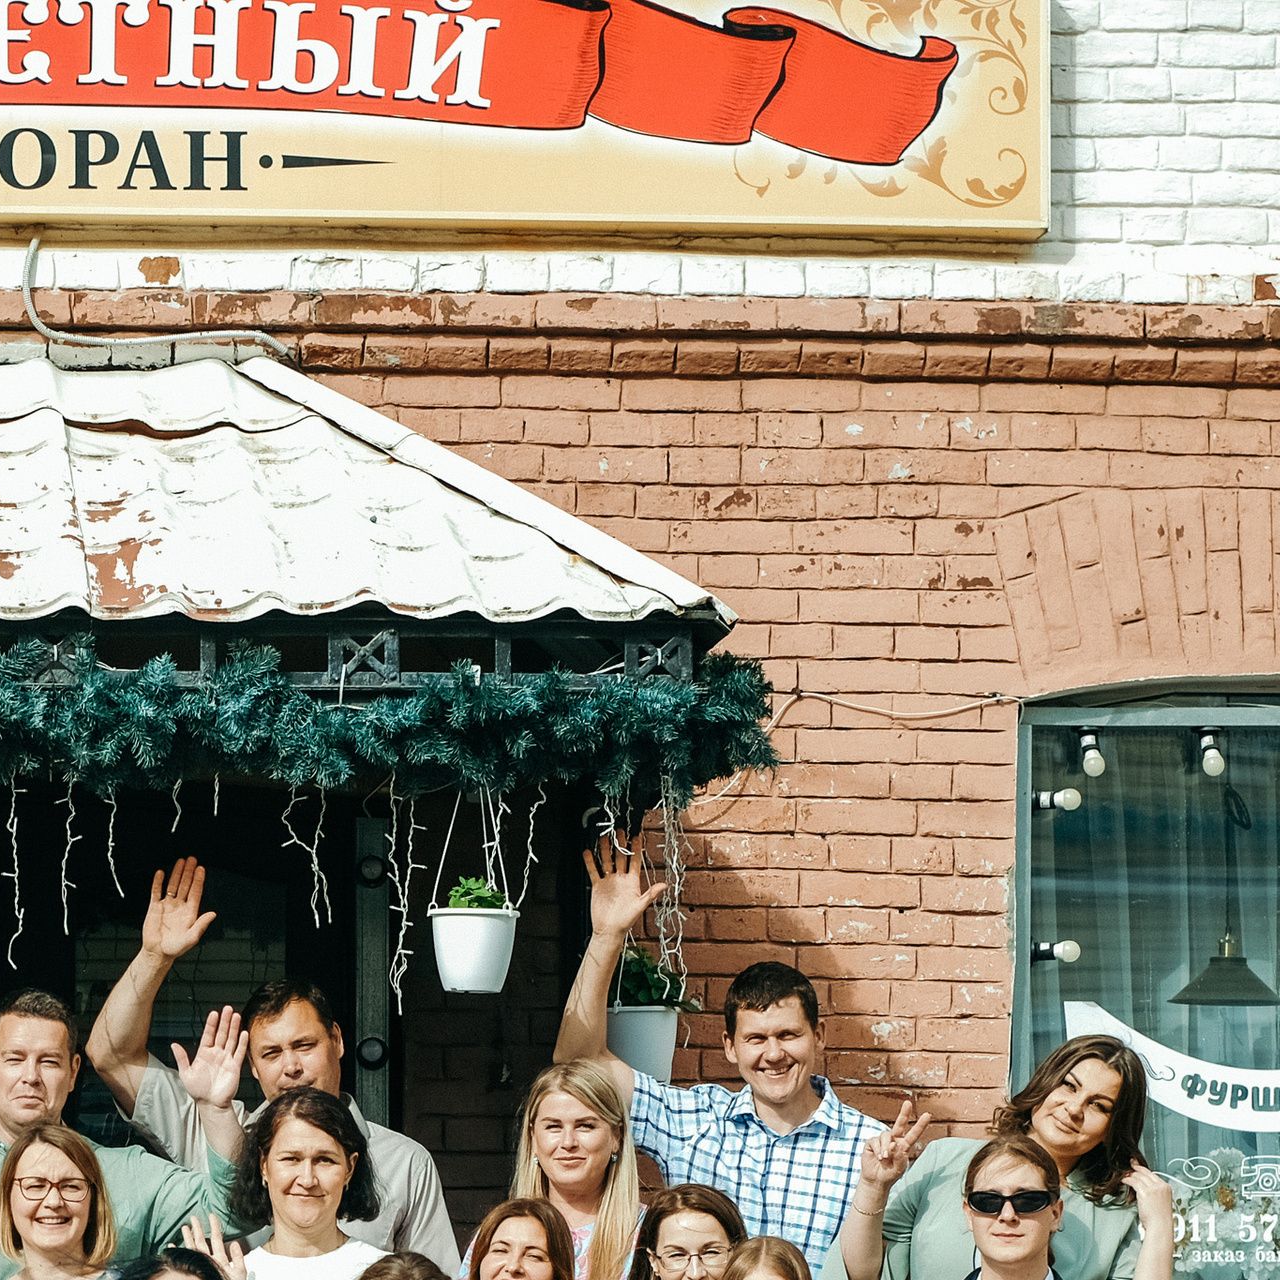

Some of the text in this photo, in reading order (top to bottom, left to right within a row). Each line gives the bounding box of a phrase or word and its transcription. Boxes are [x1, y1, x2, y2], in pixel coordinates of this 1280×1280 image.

[1239, 1213, 1278, 1242] 57
[1192, 1246, 1280, 1263] заказ ба
